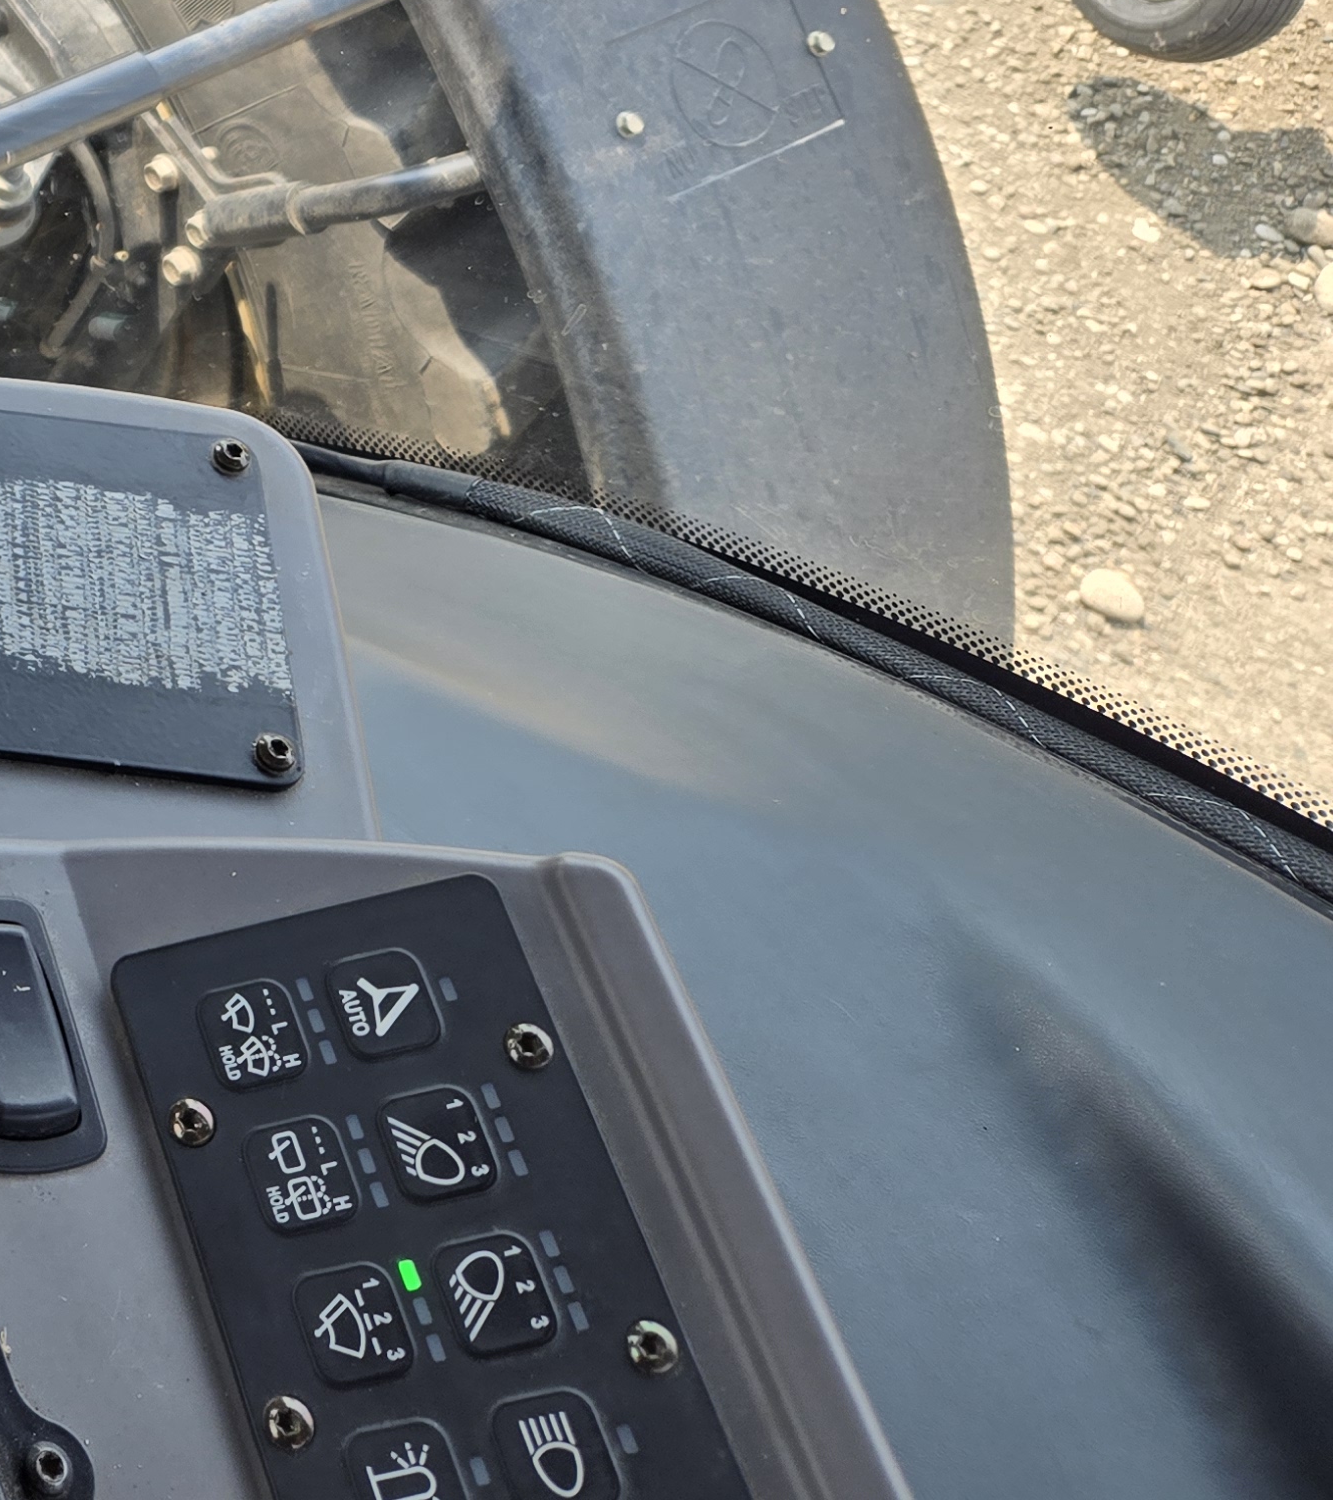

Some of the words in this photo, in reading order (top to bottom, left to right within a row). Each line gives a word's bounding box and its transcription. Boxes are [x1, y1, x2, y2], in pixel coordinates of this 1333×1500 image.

[338, 989, 370, 1036] AUTO
[272, 1022, 288, 1034] L
[219, 1045, 242, 1081] HOLD
[283, 1053, 302, 1068] H
[446, 1098, 464, 1109] 1
[457, 1130, 476, 1144] 2
[320, 1161, 337, 1175] L
[471, 1164, 490, 1177] 3
[266, 1185, 290, 1223] HOLD
[333, 1195, 352, 1211] H
[504, 1245, 522, 1256] 1
[362, 1277, 381, 1288] 1
[515, 1280, 535, 1294] 2
[374, 1312, 393, 1326] 2
[530, 1315, 550, 1329] 3
[386, 1347, 405, 1361] 3
